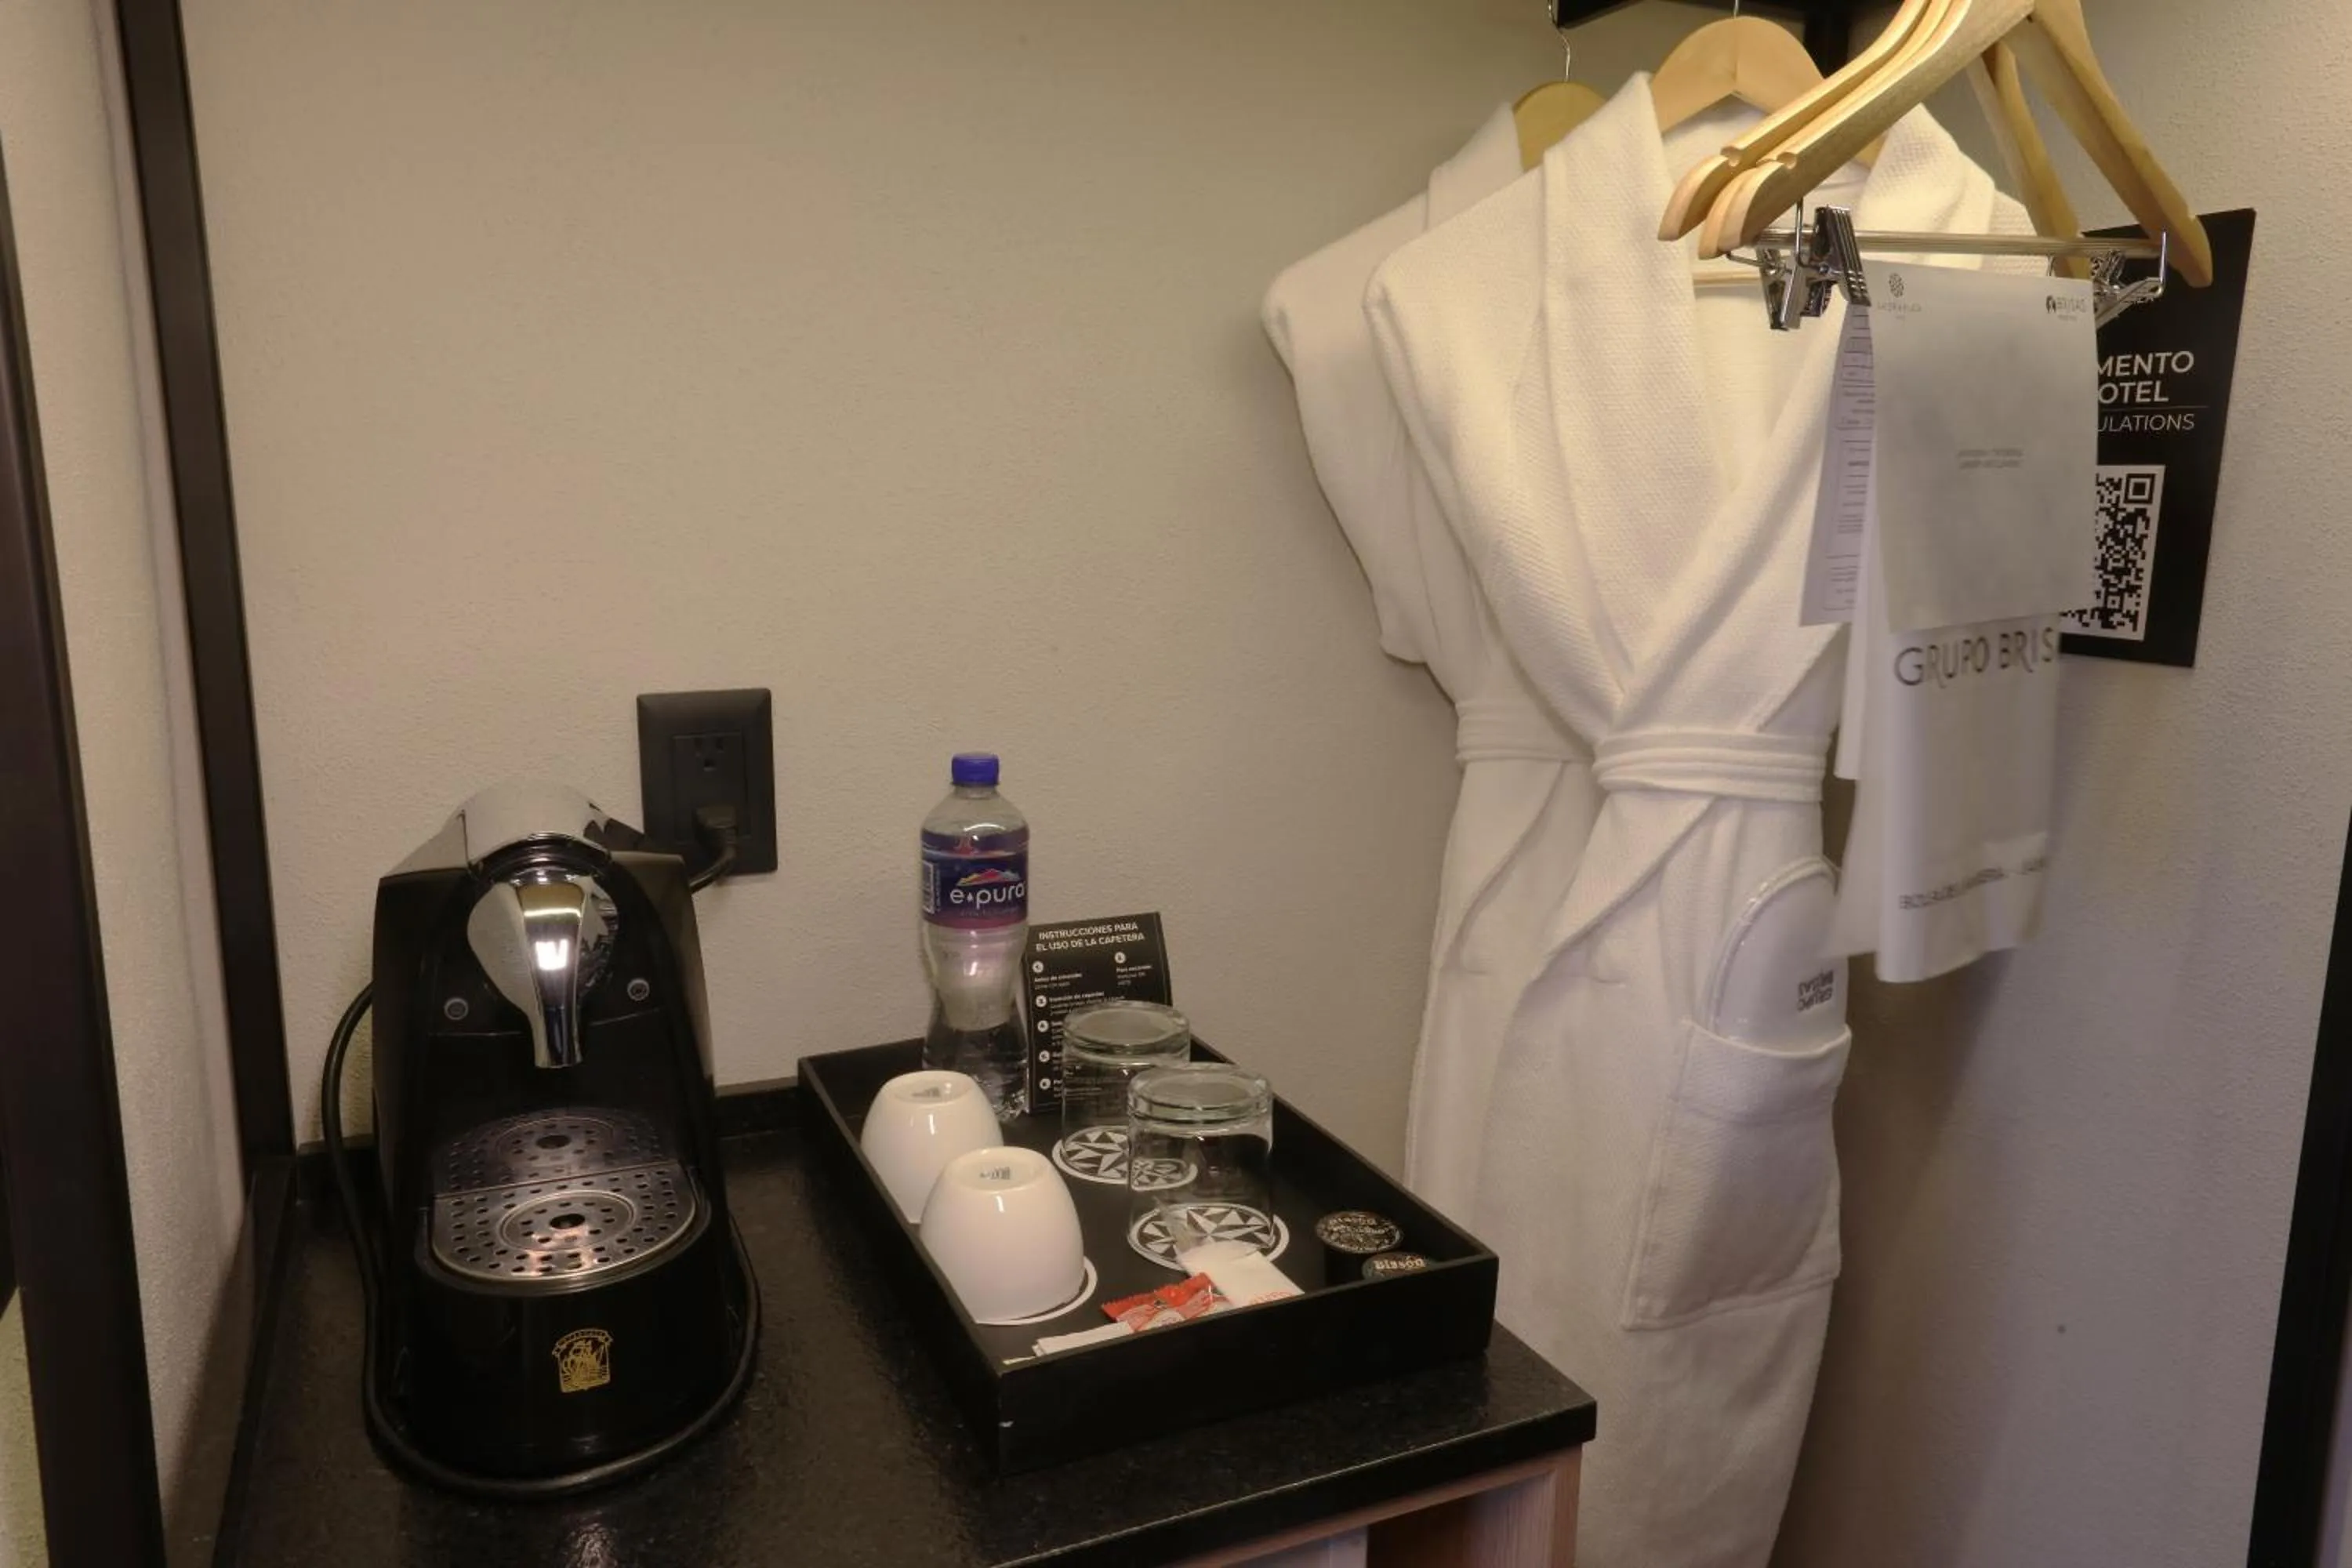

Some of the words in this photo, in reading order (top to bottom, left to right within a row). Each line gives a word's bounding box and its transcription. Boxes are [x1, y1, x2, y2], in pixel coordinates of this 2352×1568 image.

[1893, 636, 1991, 688] GRUPO
[1039, 924, 1112, 940] INSTRUCCIONES
[1114, 922, 1138, 933] PARA
[1036, 943, 1047, 952] EL
[1049, 941, 1069, 951] USO
[1071, 939, 1083, 948] DE
[1086, 938, 1097, 946] LA
[1098, 932, 1145, 945] CAFETERA
